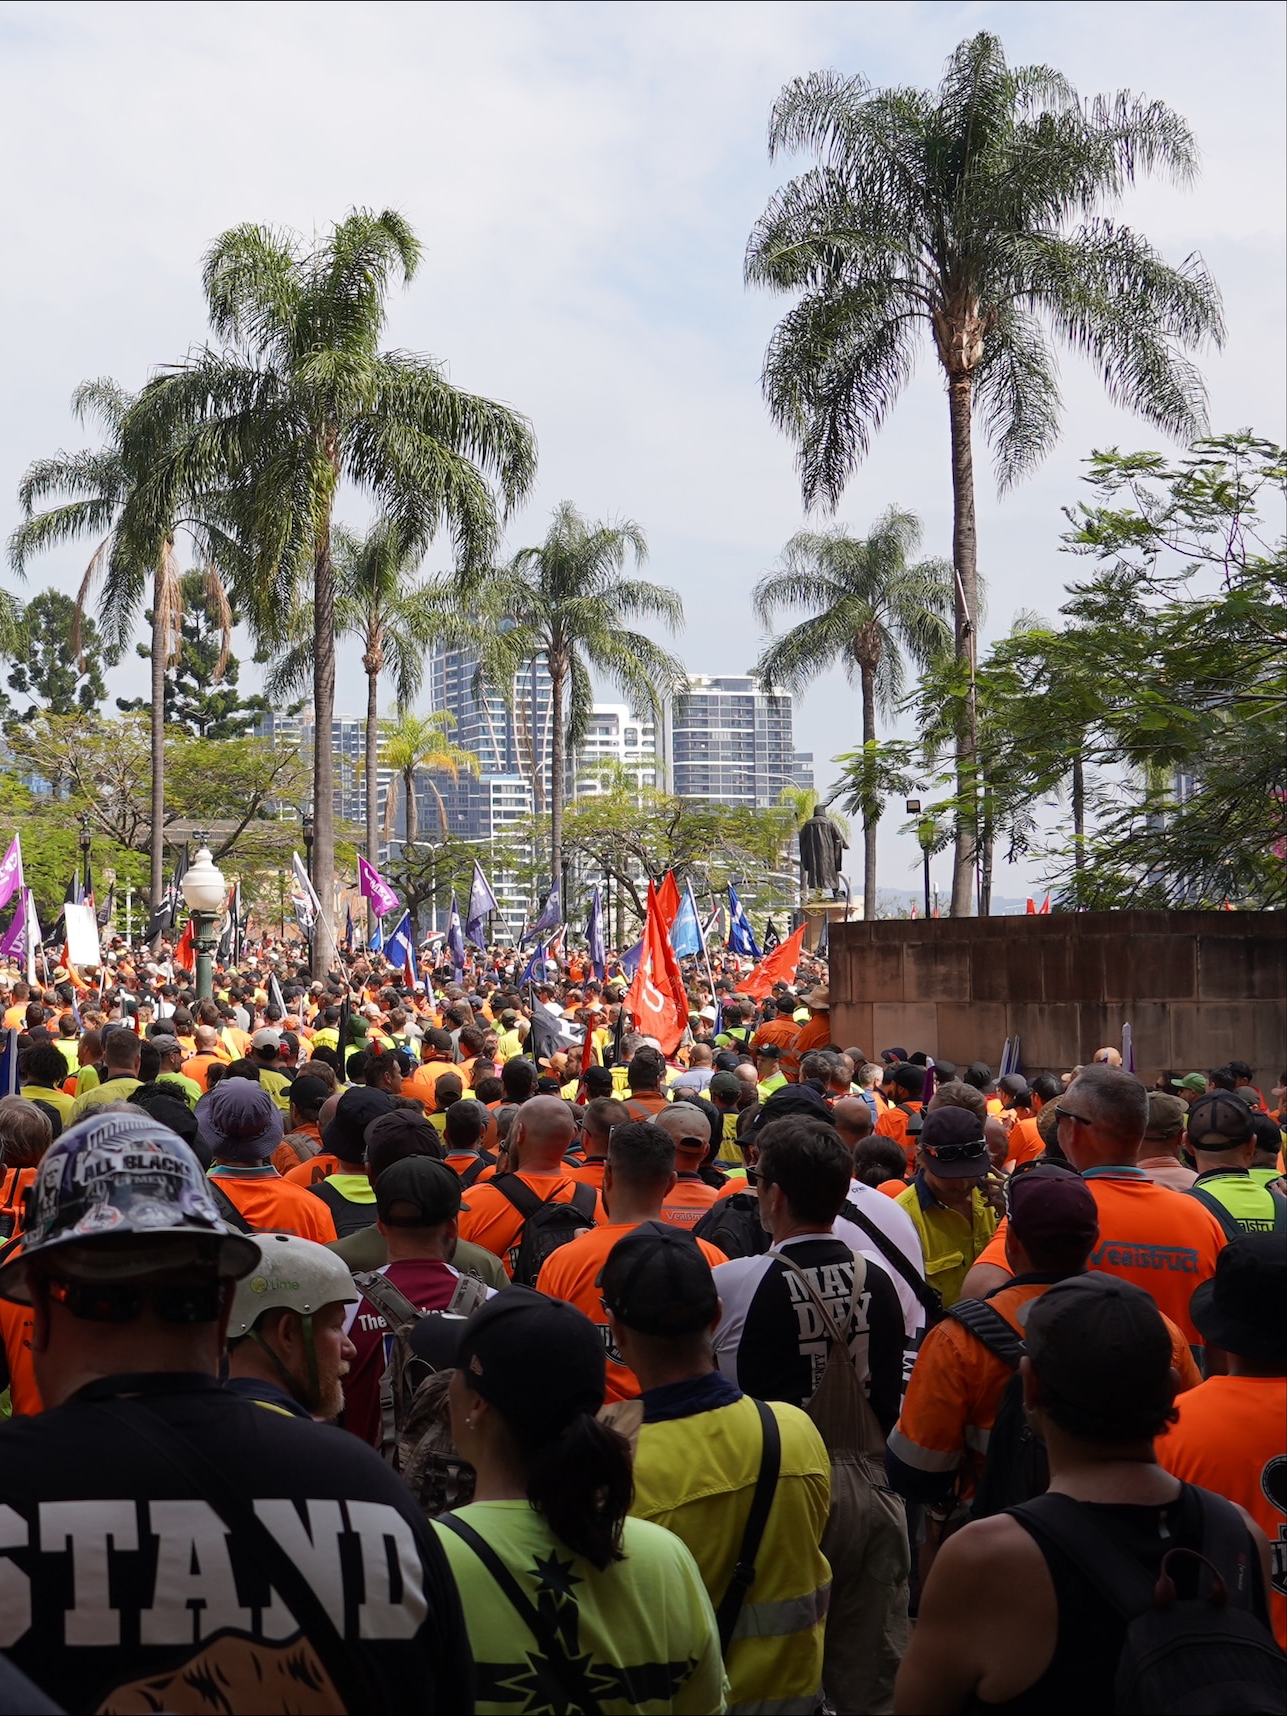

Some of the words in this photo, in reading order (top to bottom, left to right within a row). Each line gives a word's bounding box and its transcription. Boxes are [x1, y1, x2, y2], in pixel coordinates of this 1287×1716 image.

[84, 1157, 117, 1183] ALL
[271, 1278, 300, 1291] Lime
[358, 1314, 388, 1332] The
